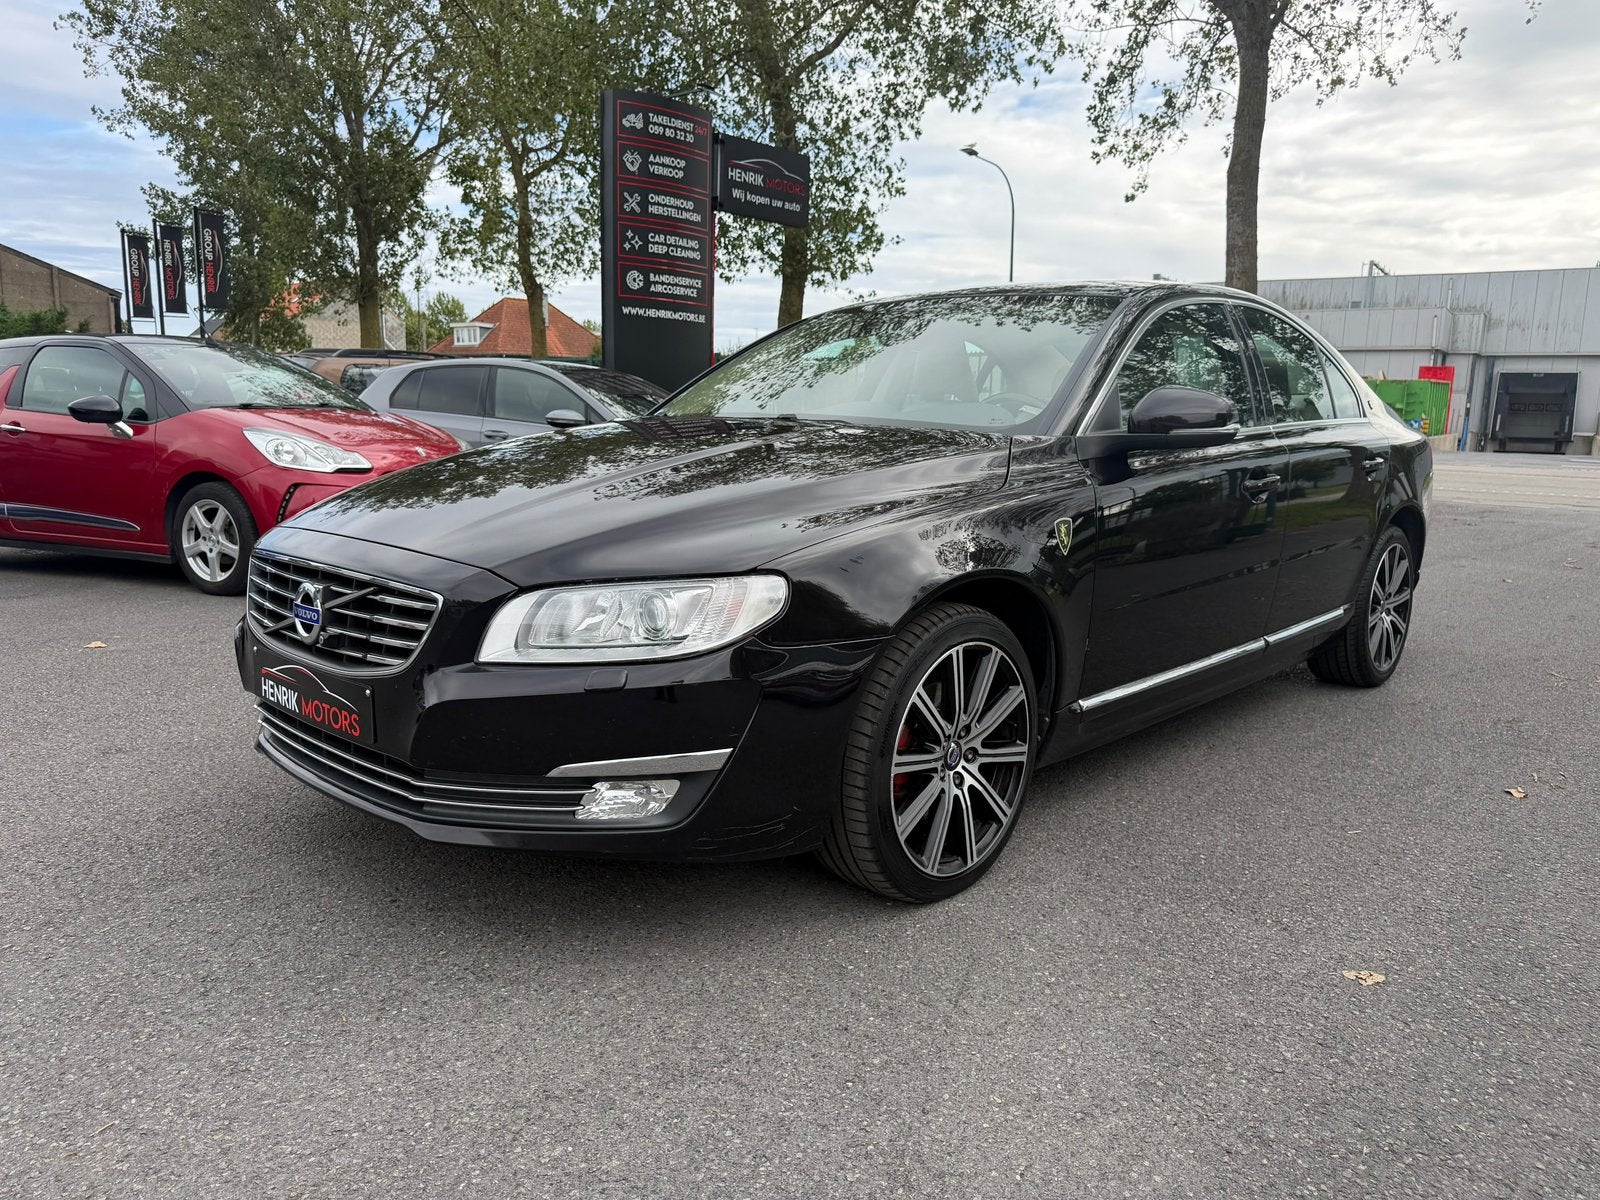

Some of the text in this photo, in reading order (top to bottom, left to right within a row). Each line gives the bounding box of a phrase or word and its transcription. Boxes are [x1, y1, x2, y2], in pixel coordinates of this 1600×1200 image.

[648, 112, 707, 136] TAKELDIENST 24/7
[648, 124, 694, 143] 059 80 32 30
[648, 154, 686, 168] AANKOOP
[648, 164, 684, 179] VERKOOP
[728, 167, 806, 197] HENRIK MOTORS
[648, 193, 694, 210] ONDERHOUD
[732, 187, 800, 212] Wij kopen uw auto
[648, 204, 702, 223] HERSTELLINGEN
[648, 233, 699, 249] CAR DETAILING
[203, 228, 216, 293] GROUP HENRIK
[648, 244, 701, 260] DEEP CLEANING
[130, 247, 142, 305] GROUP HENRIK
[163, 239, 176, 301] HENRIK MOTORS
[649, 272, 702, 288] BANDENSERVICE
[650, 284, 698, 298] AIRCOSERVICE
[621, 306, 706, 323] WWW.HENRIKMOTORS.BE
[294, 607, 318, 621] VOLVO
[261, 676, 361, 737] HENRIK MOTORS
